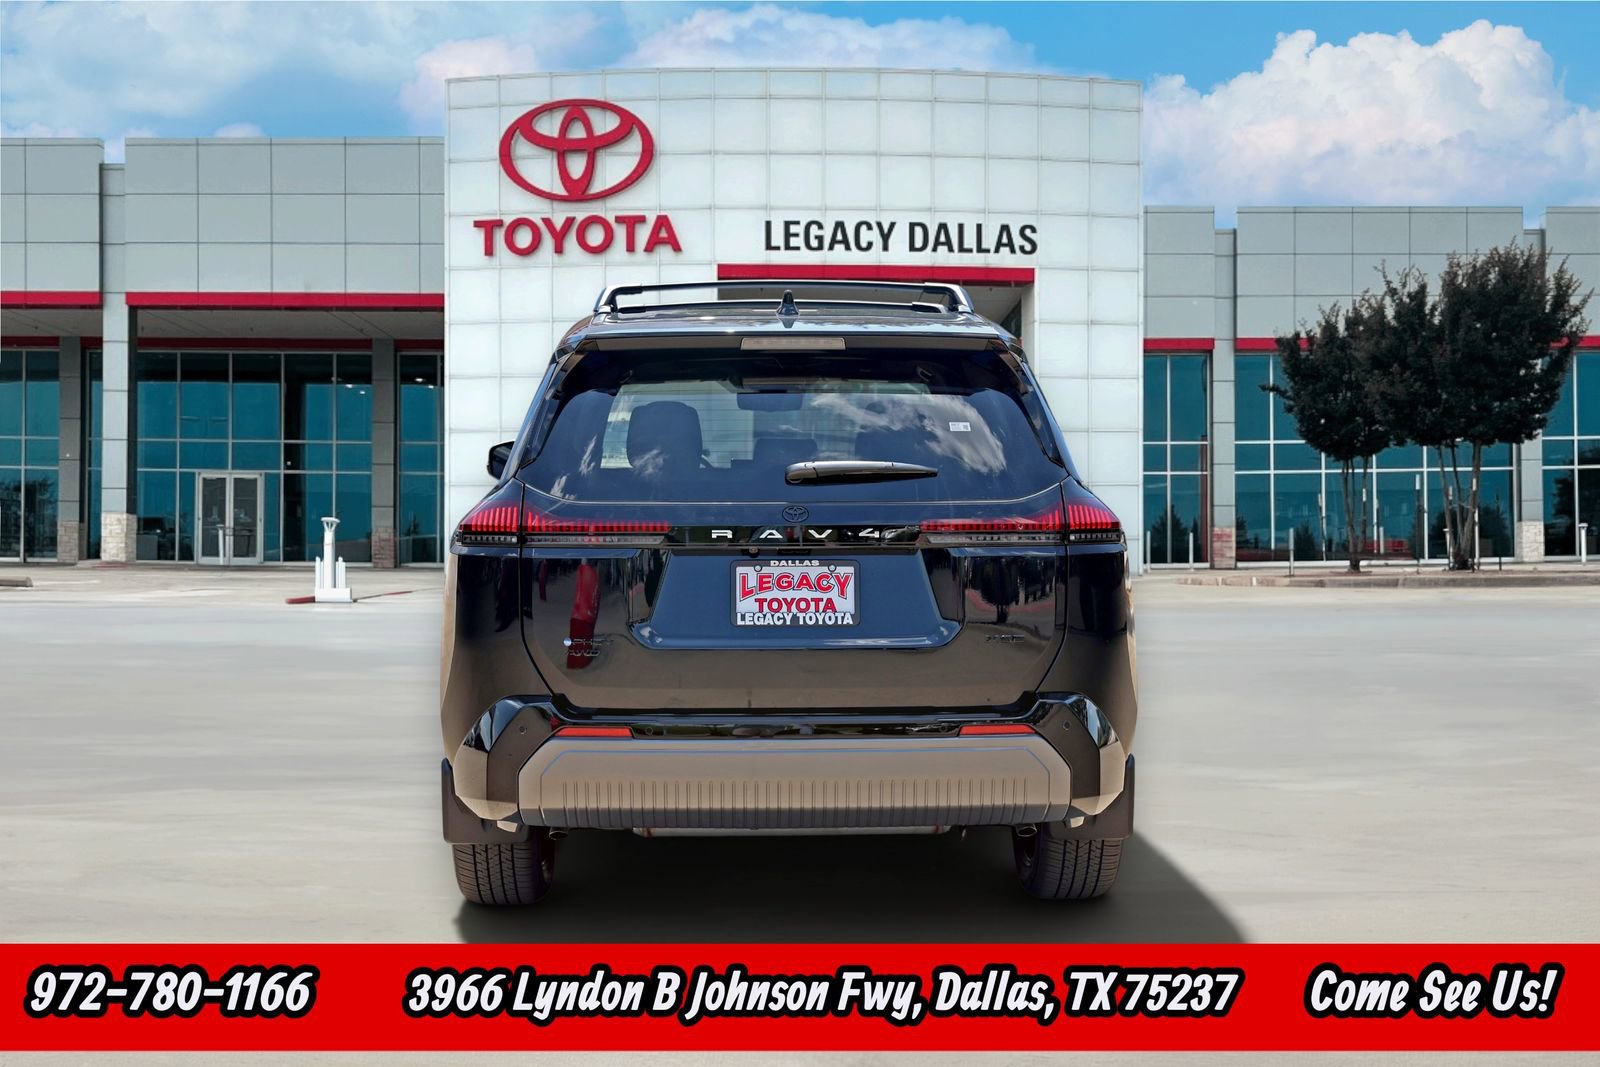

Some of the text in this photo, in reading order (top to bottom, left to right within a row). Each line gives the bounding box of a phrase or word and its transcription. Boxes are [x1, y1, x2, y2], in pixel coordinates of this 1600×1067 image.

[474, 214, 682, 257] TOYOTA
[765, 220, 1038, 256] LEGACY DALLAS
[711, 528, 880, 539] RAV4
[770, 559, 820, 567] DALLAS
[738, 572, 853, 602] LEGACY
[754, 597, 838, 613] TOYOTA
[736, 612, 853, 626] LEGACY TOYOTA
